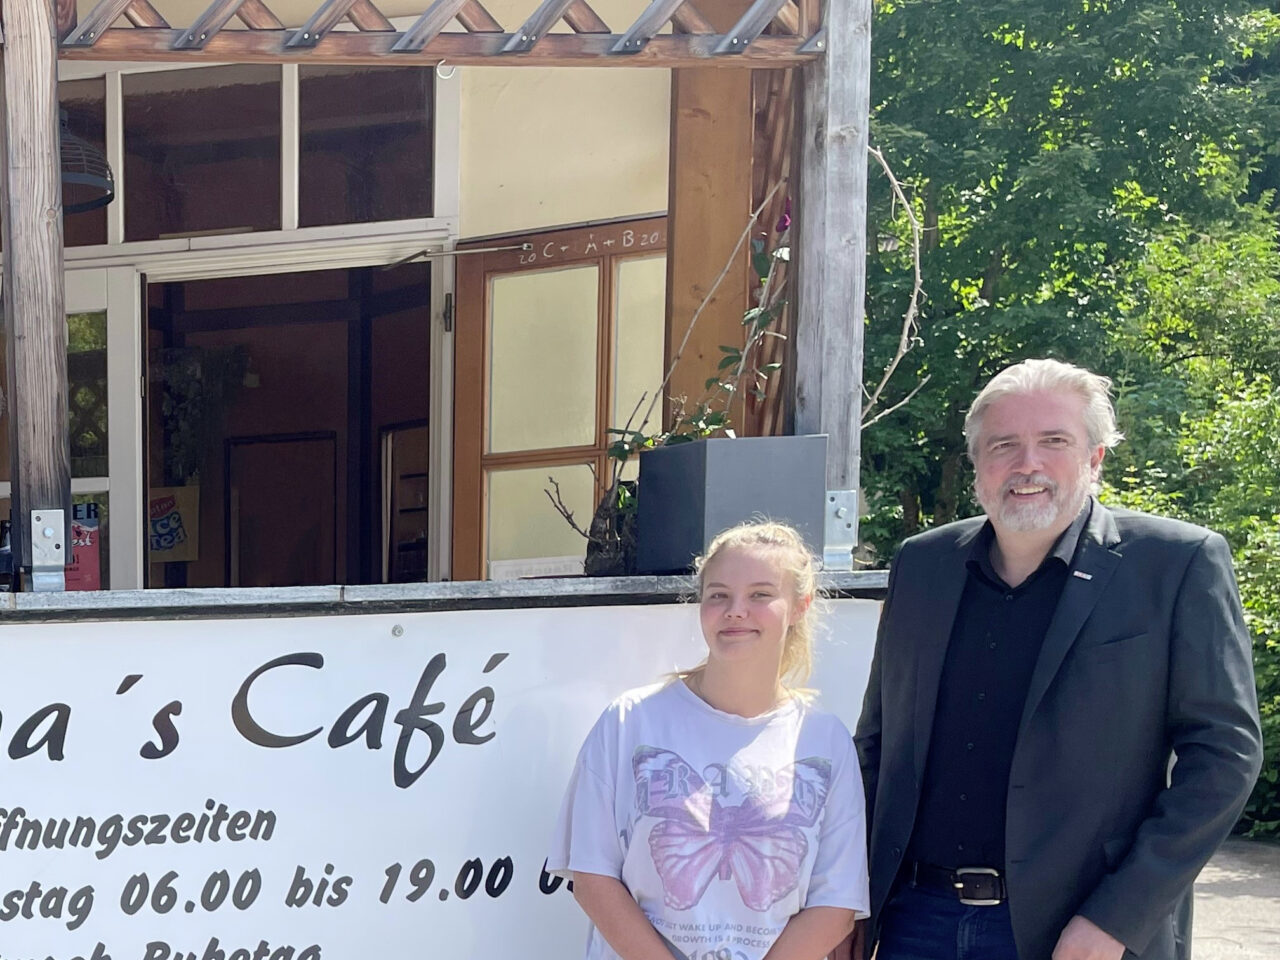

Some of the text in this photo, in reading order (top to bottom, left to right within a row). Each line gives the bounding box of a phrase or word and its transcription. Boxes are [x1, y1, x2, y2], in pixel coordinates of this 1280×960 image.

[623, 230, 634, 247] B
[231, 652, 509, 789] Café
[121, 868, 261, 915] 06.00
[286, 864, 353, 908] bis
[379, 856, 514, 904] 19.00
